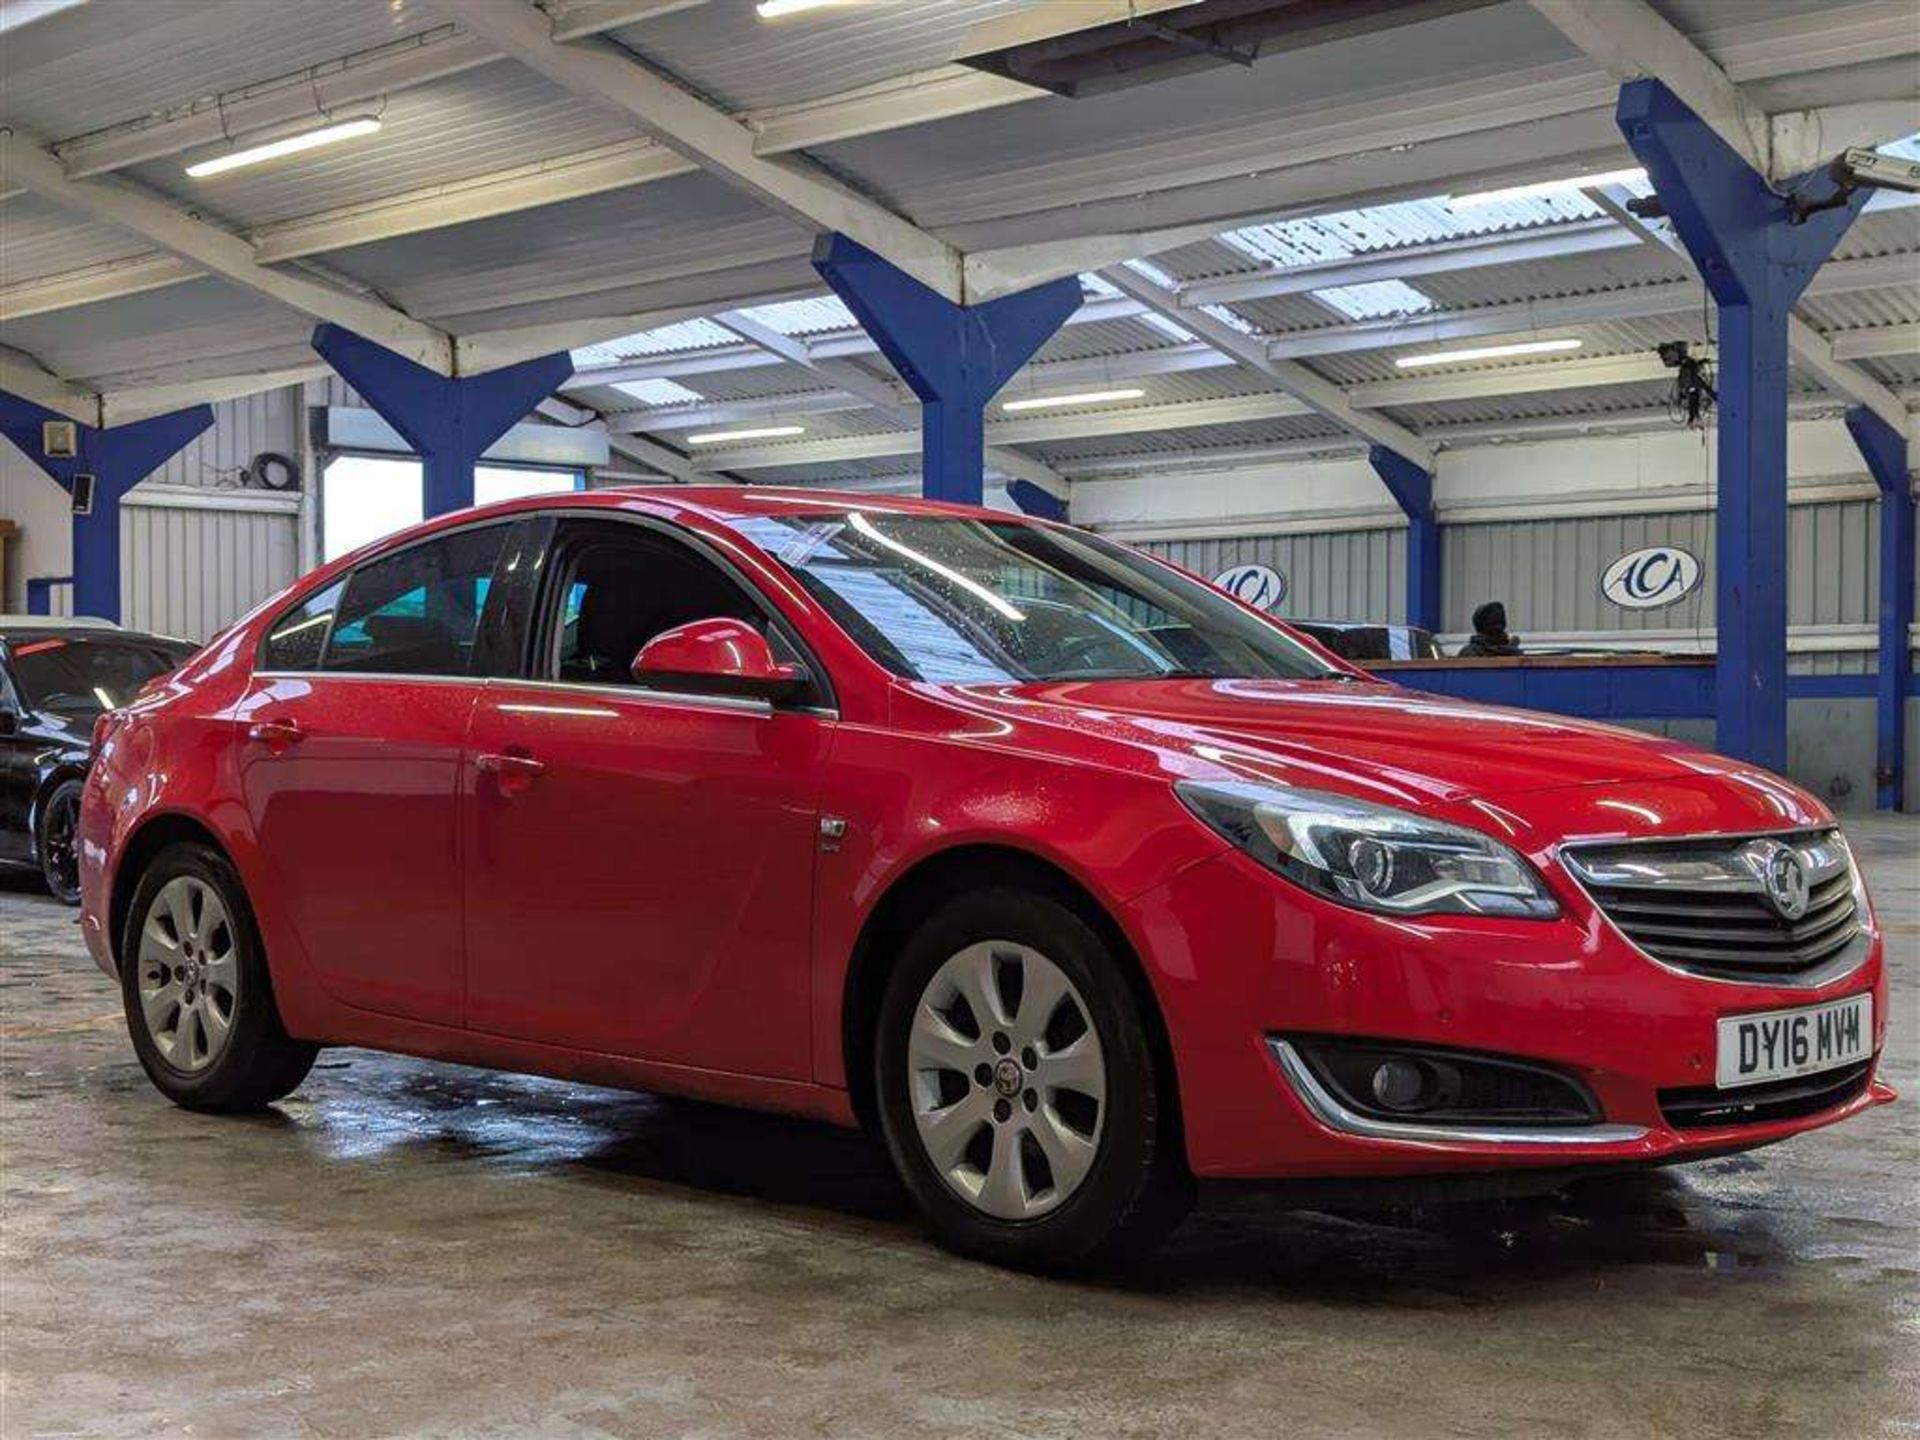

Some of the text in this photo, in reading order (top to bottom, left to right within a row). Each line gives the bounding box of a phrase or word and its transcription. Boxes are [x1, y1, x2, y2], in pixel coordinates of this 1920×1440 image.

[1607, 553, 1684, 600] ACA
[1739, 1004, 1860, 1073] DY16 MVM
